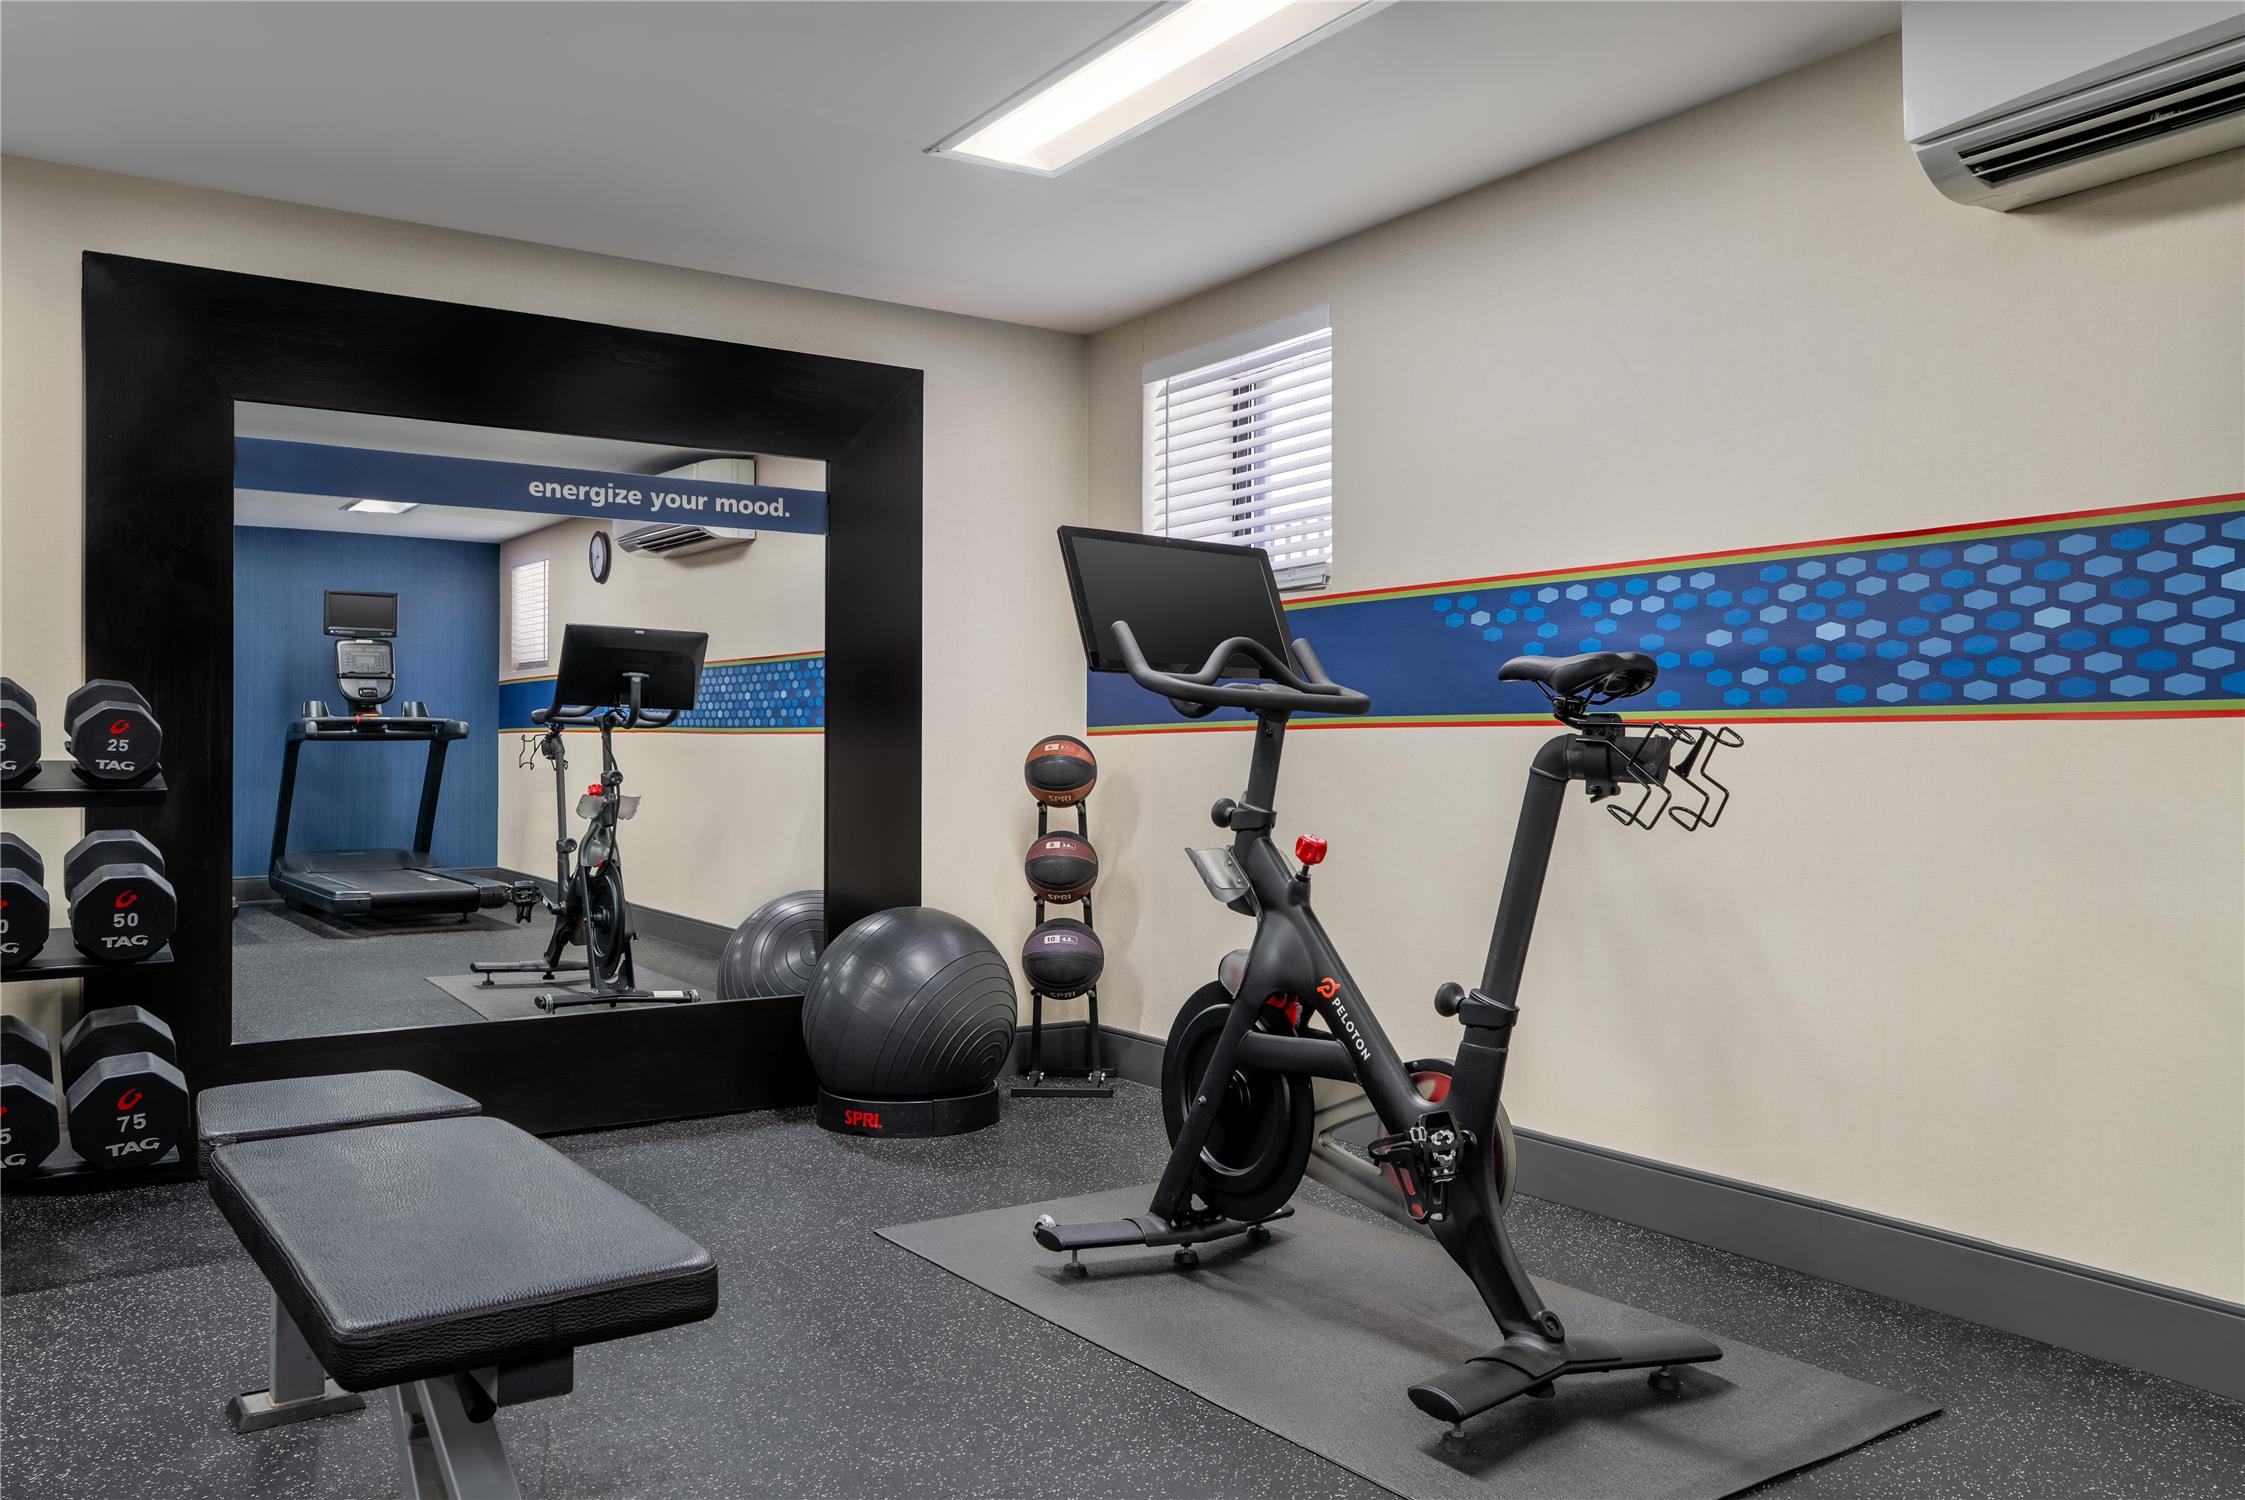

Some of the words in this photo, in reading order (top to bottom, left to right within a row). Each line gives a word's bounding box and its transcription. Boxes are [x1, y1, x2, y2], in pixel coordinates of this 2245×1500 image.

[528, 480, 642, 507] energize
[650, 490, 708, 511] your
[715, 498, 790, 517] mood.
[107, 739, 130, 752] 25
[95, 759, 136, 771] TAG
[113, 912, 139, 928] 50
[101, 934, 149, 948] TAG
[1331, 997, 1371, 1061] PELOTON
[116, 1112, 147, 1133] 75
[844, 1110, 880, 1128] SPRI
[105, 1137, 161, 1157] TAG
